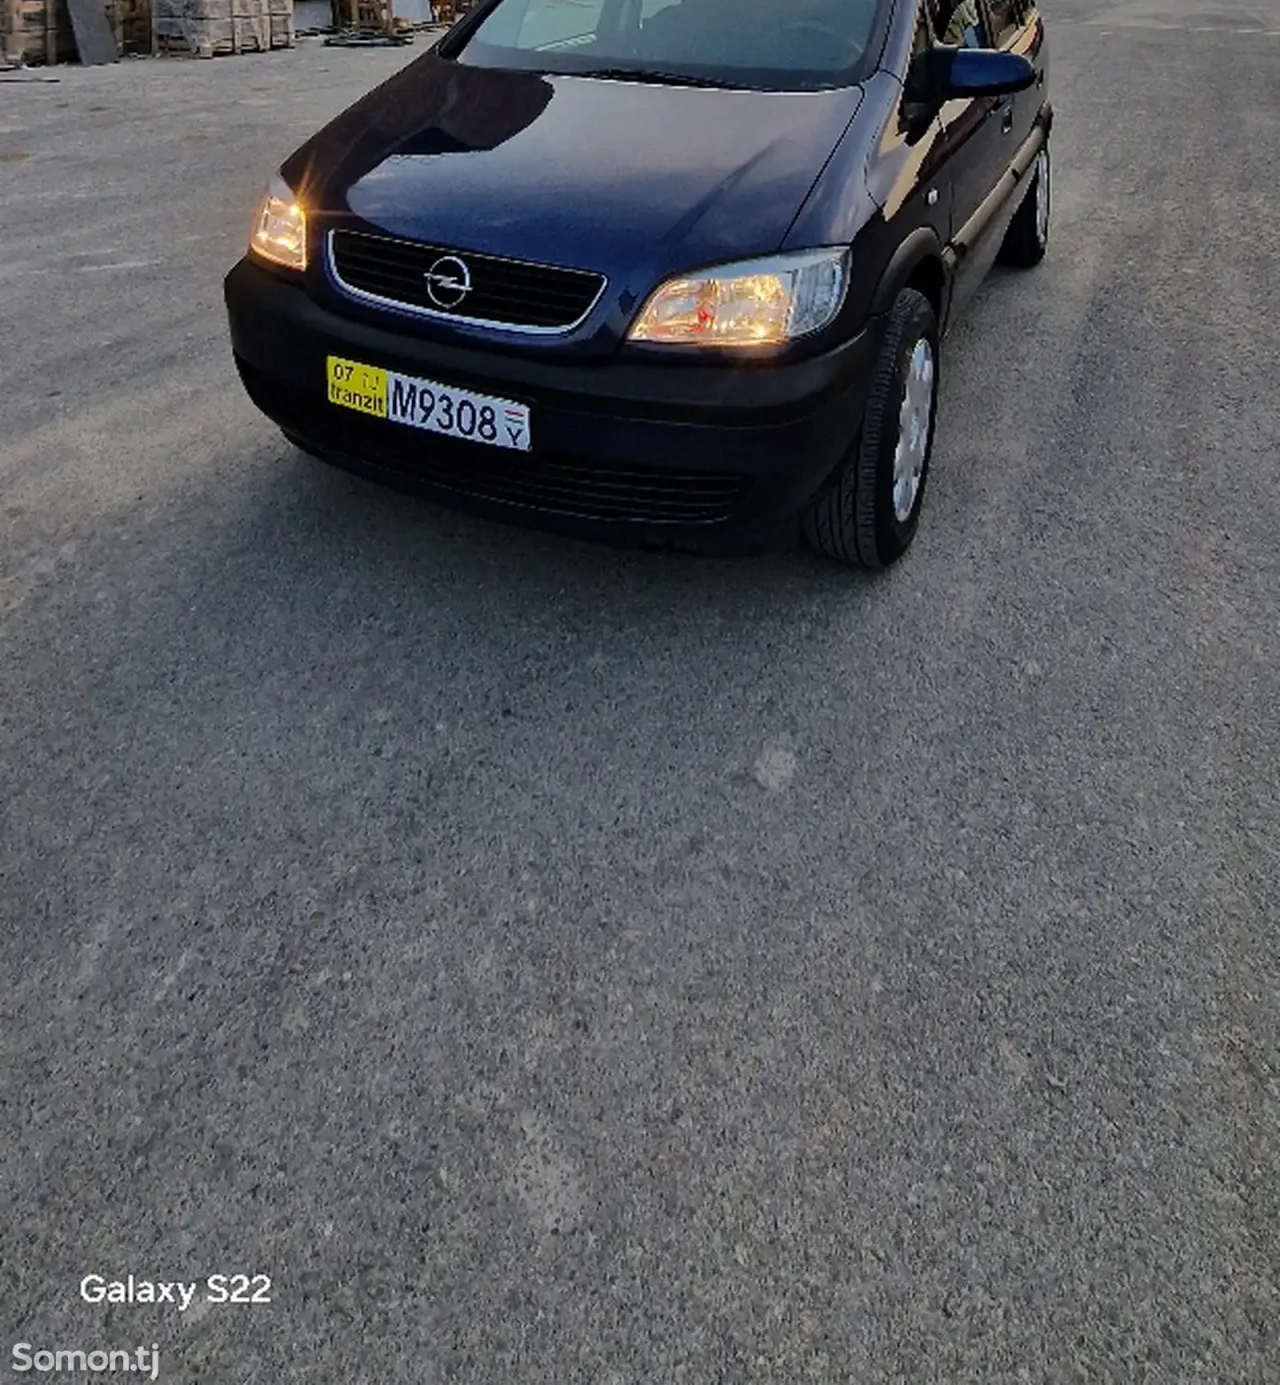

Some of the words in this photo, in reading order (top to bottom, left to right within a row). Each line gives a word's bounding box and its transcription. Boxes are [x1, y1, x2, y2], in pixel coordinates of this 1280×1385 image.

[333, 363, 354, 381] 07
[330, 383, 384, 413] tranzit
[392, 379, 498, 441] M9308
